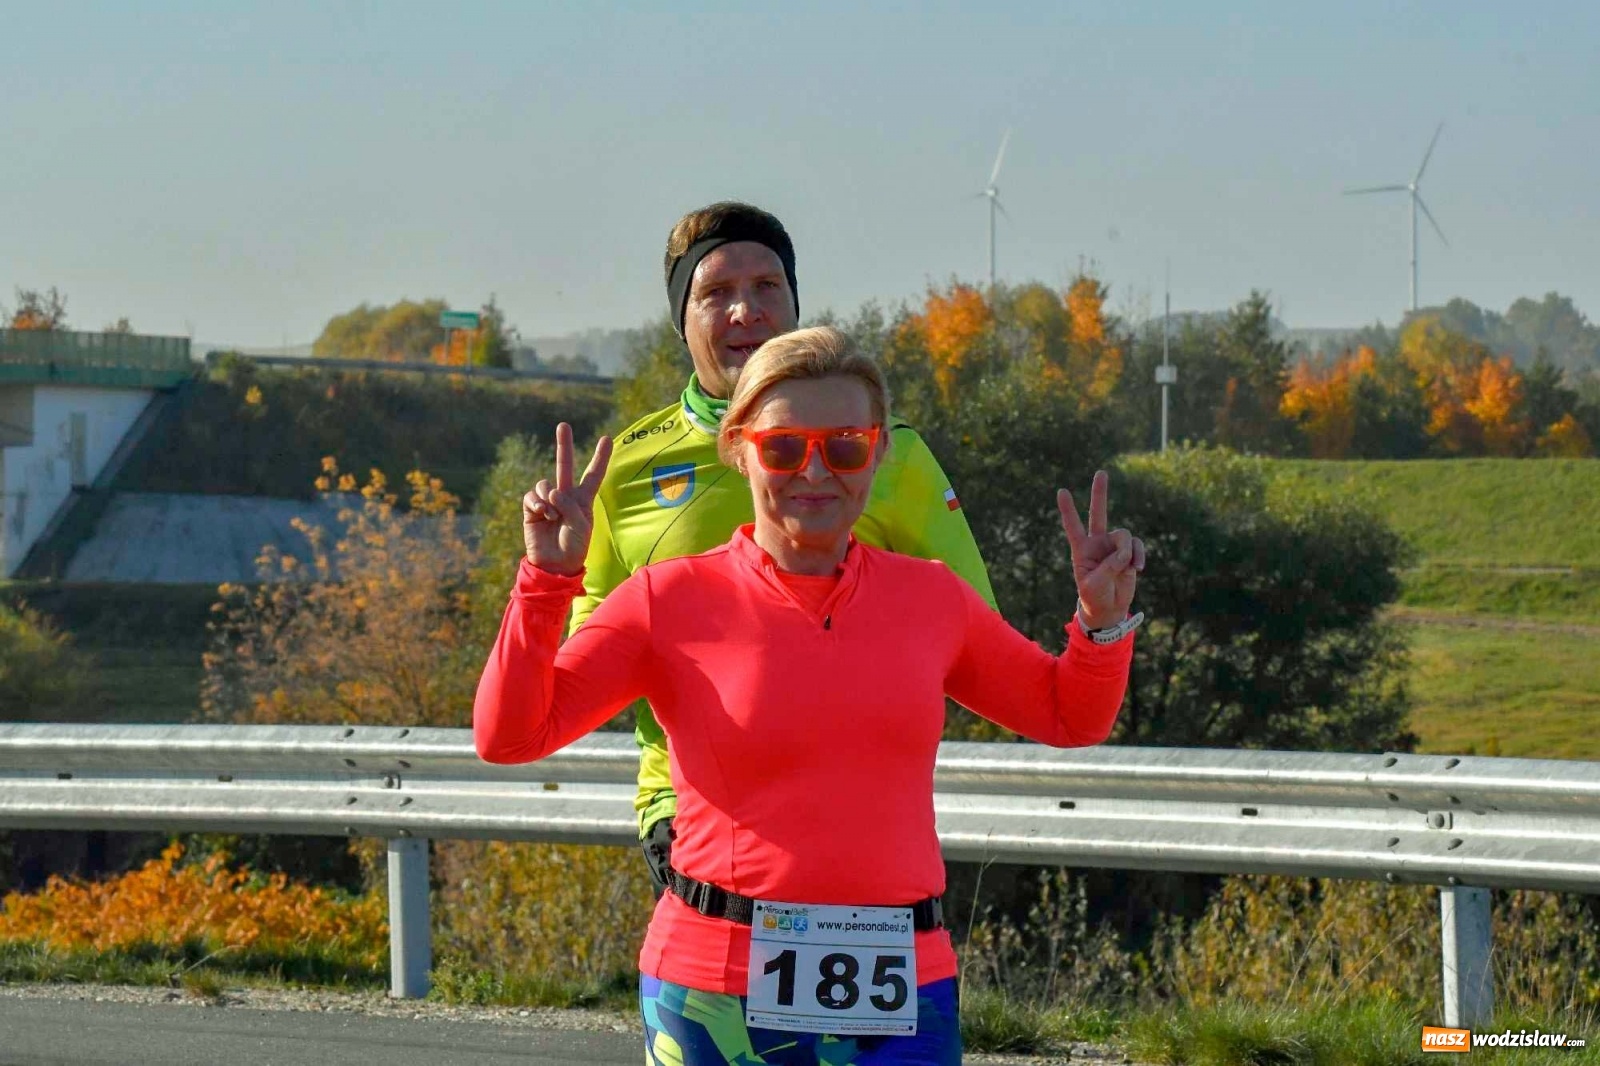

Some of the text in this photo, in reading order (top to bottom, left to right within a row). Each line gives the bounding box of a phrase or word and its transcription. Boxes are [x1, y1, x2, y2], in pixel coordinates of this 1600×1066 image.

[623, 421, 674, 444] deep
[817, 921, 909, 933] www.personalbest.pl
[764, 949, 908, 1011] 185
